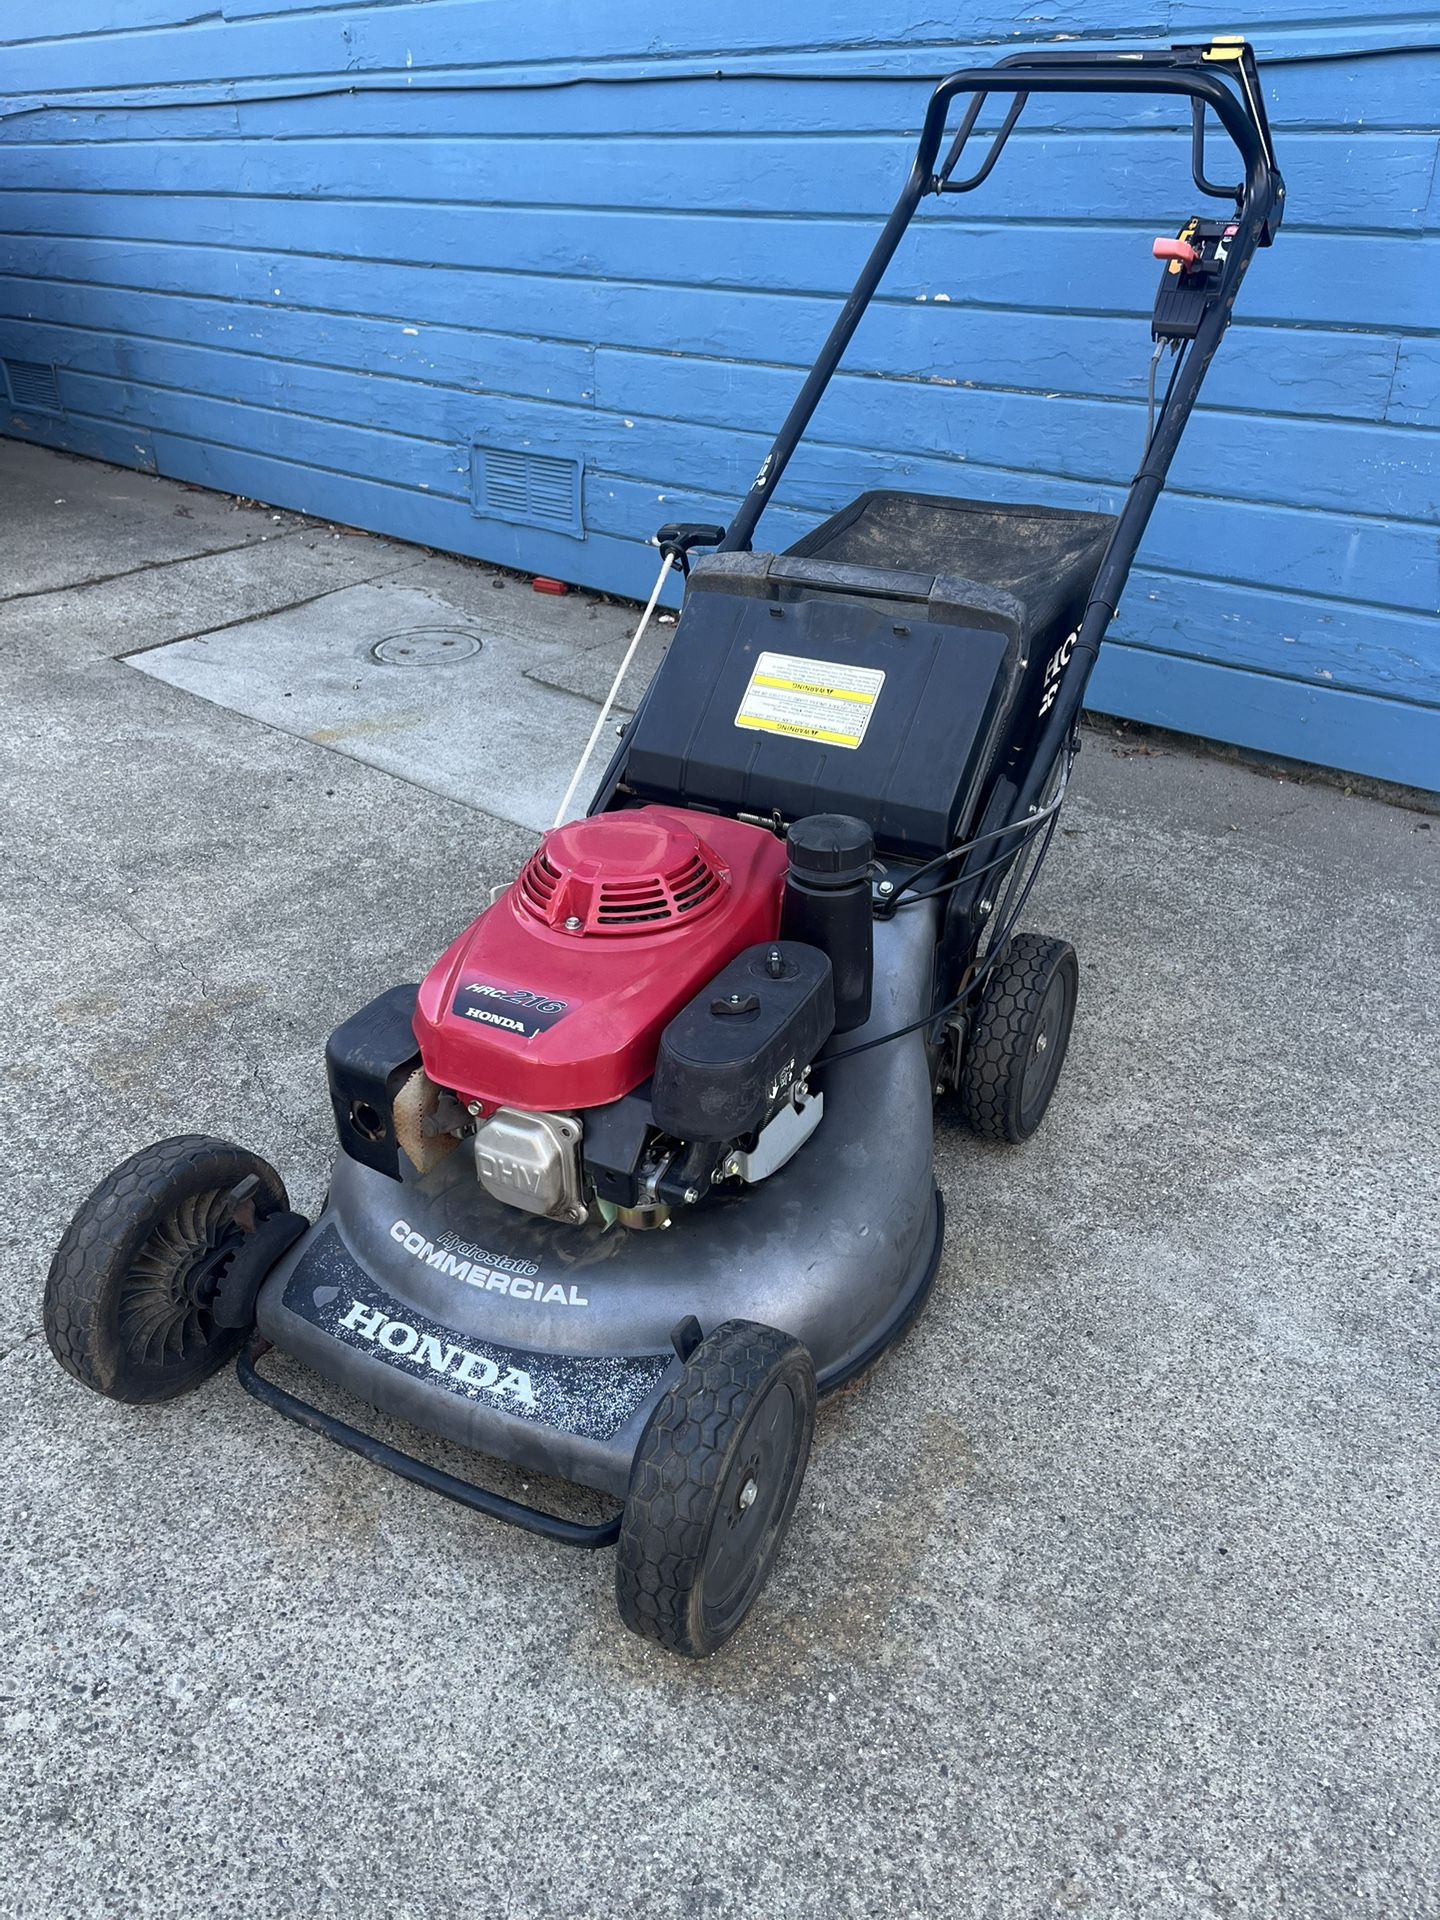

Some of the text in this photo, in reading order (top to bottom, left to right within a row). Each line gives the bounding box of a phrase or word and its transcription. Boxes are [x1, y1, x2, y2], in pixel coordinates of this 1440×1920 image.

[792, 682, 826, 694] WARNING
[777, 723, 810, 736] WARNING
[465, 1007, 525, 1033] HONDA
[478, 1152, 542, 1194] OHV
[389, 1219, 590, 1307] COMMERCIAL
[436, 1230, 540, 1277] Hydrostatic
[338, 1300, 538, 1408] HONDA
